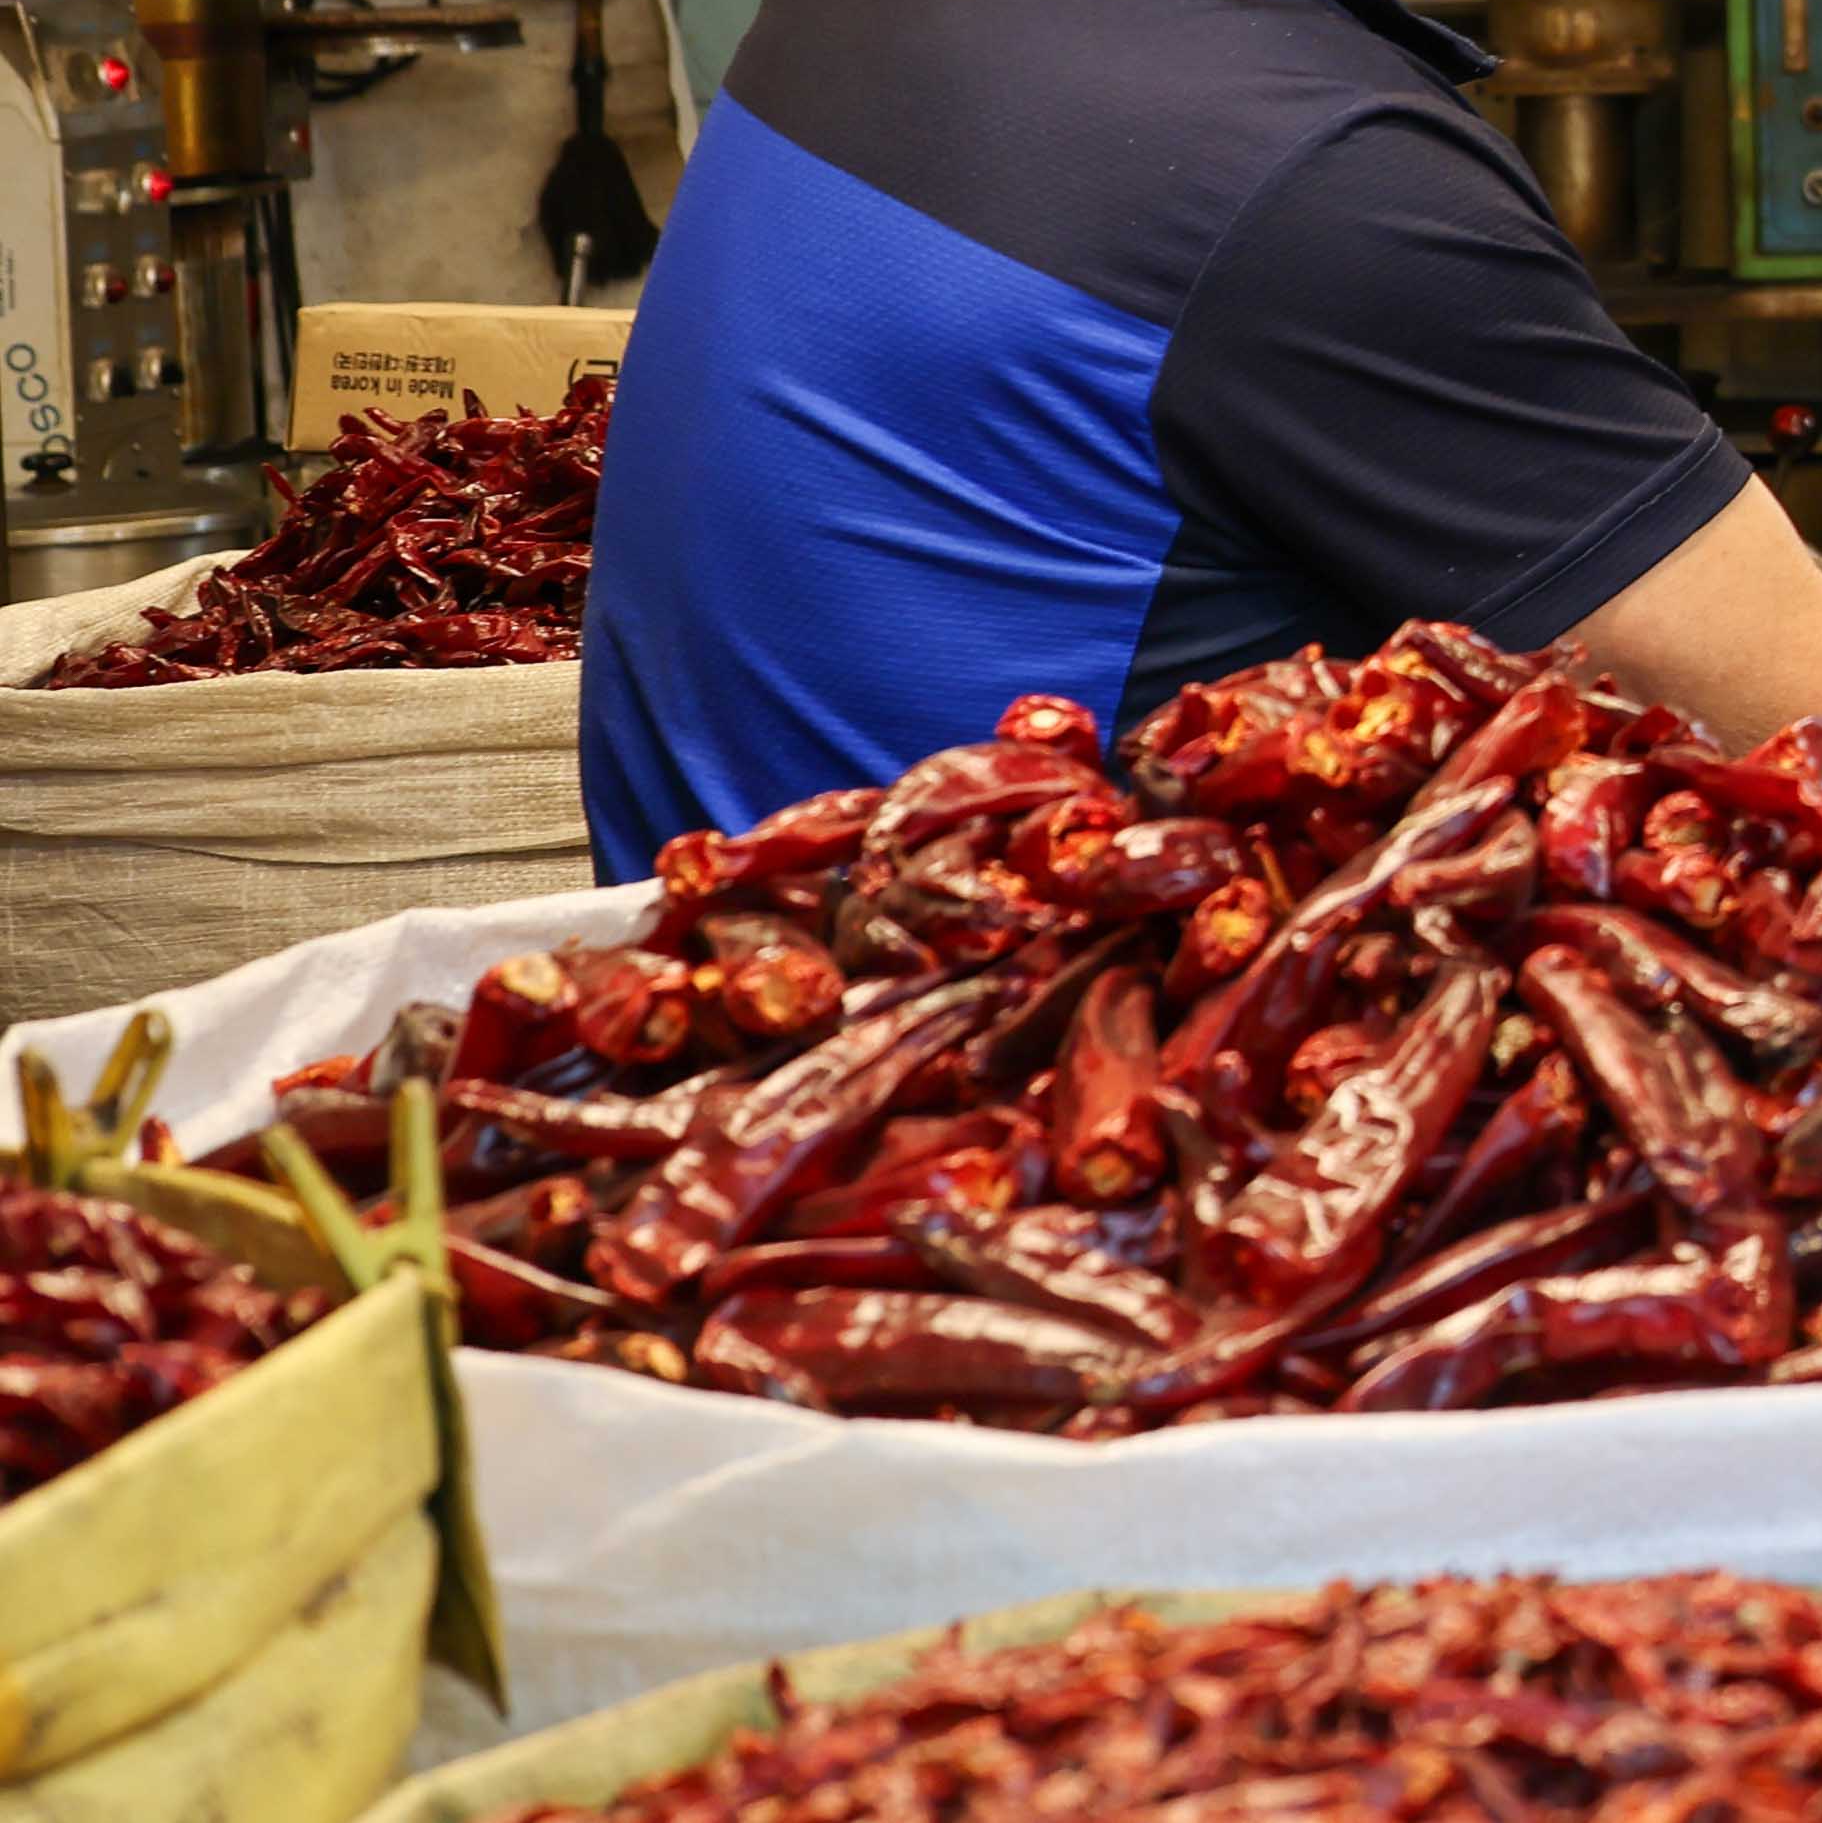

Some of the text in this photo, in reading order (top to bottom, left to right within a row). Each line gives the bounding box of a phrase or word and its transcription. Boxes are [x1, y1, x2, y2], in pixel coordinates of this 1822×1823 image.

[330, 375, 454, 400] Made in korea
